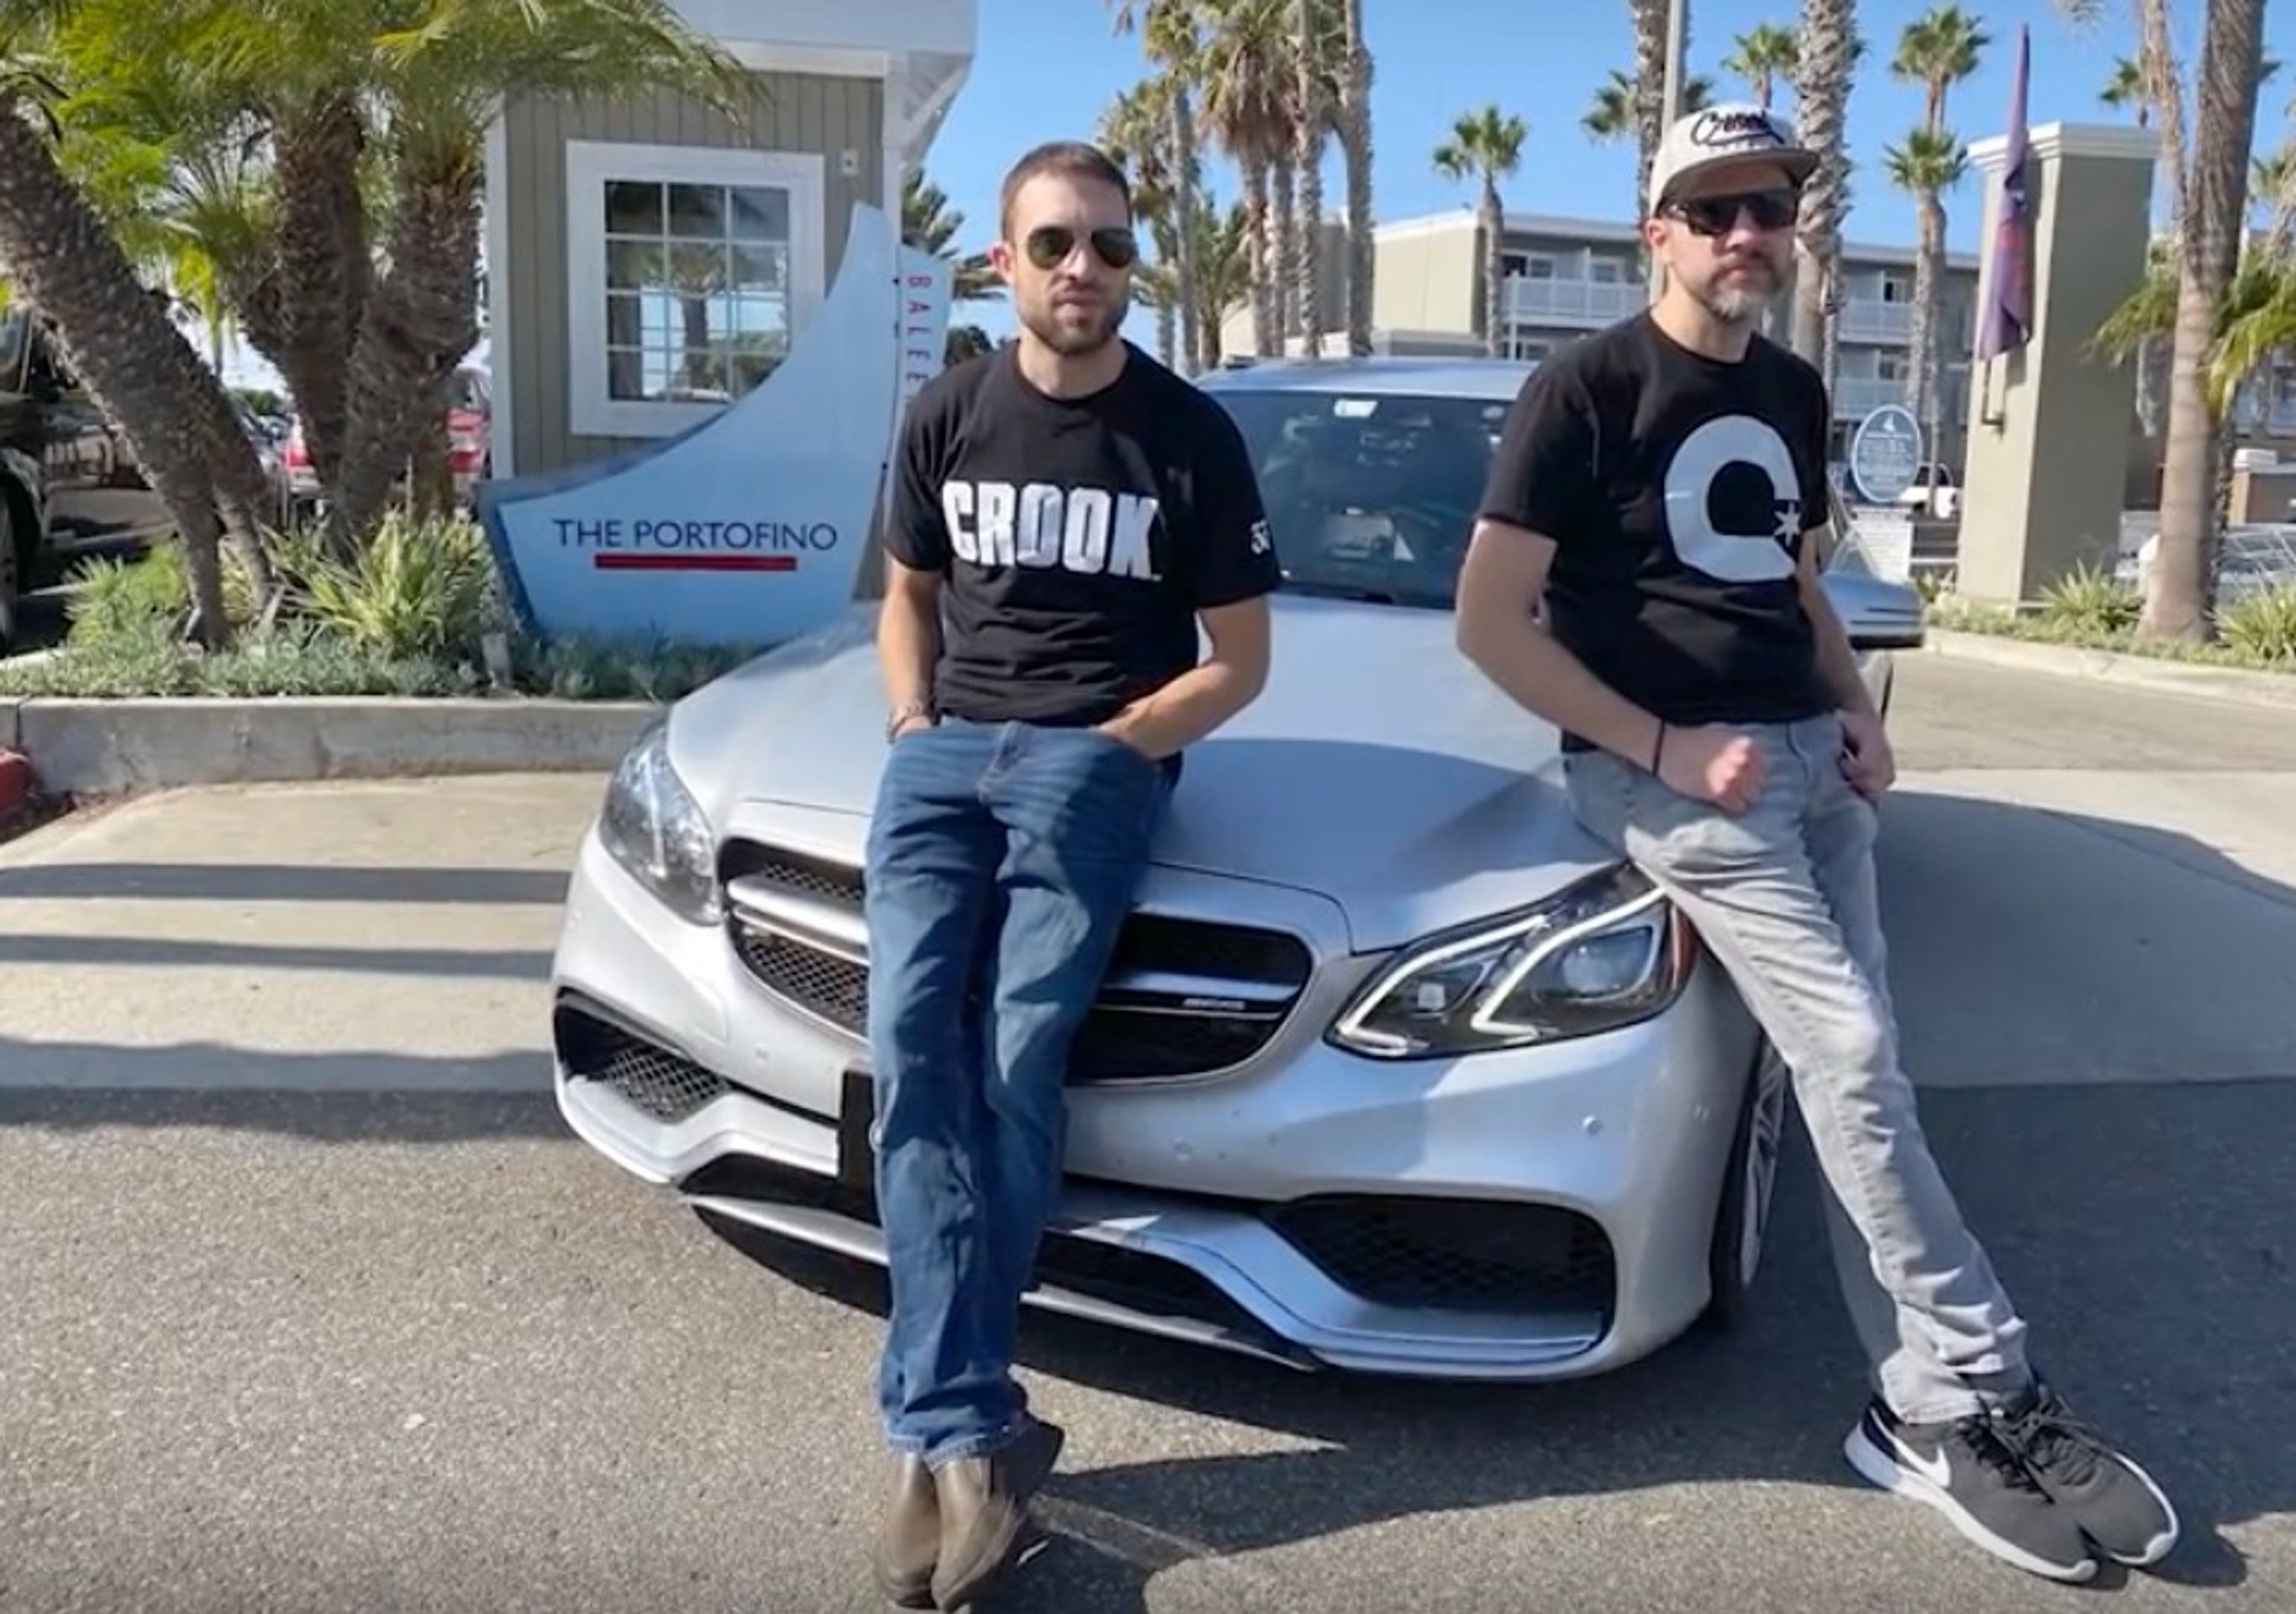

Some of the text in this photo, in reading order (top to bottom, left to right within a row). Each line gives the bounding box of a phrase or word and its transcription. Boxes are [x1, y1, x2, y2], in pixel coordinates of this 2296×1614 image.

[906, 276, 932, 402] BALEE
[552, 520, 837, 551] THE PORTOFINO
[942, 479, 1159, 582] CROOK
